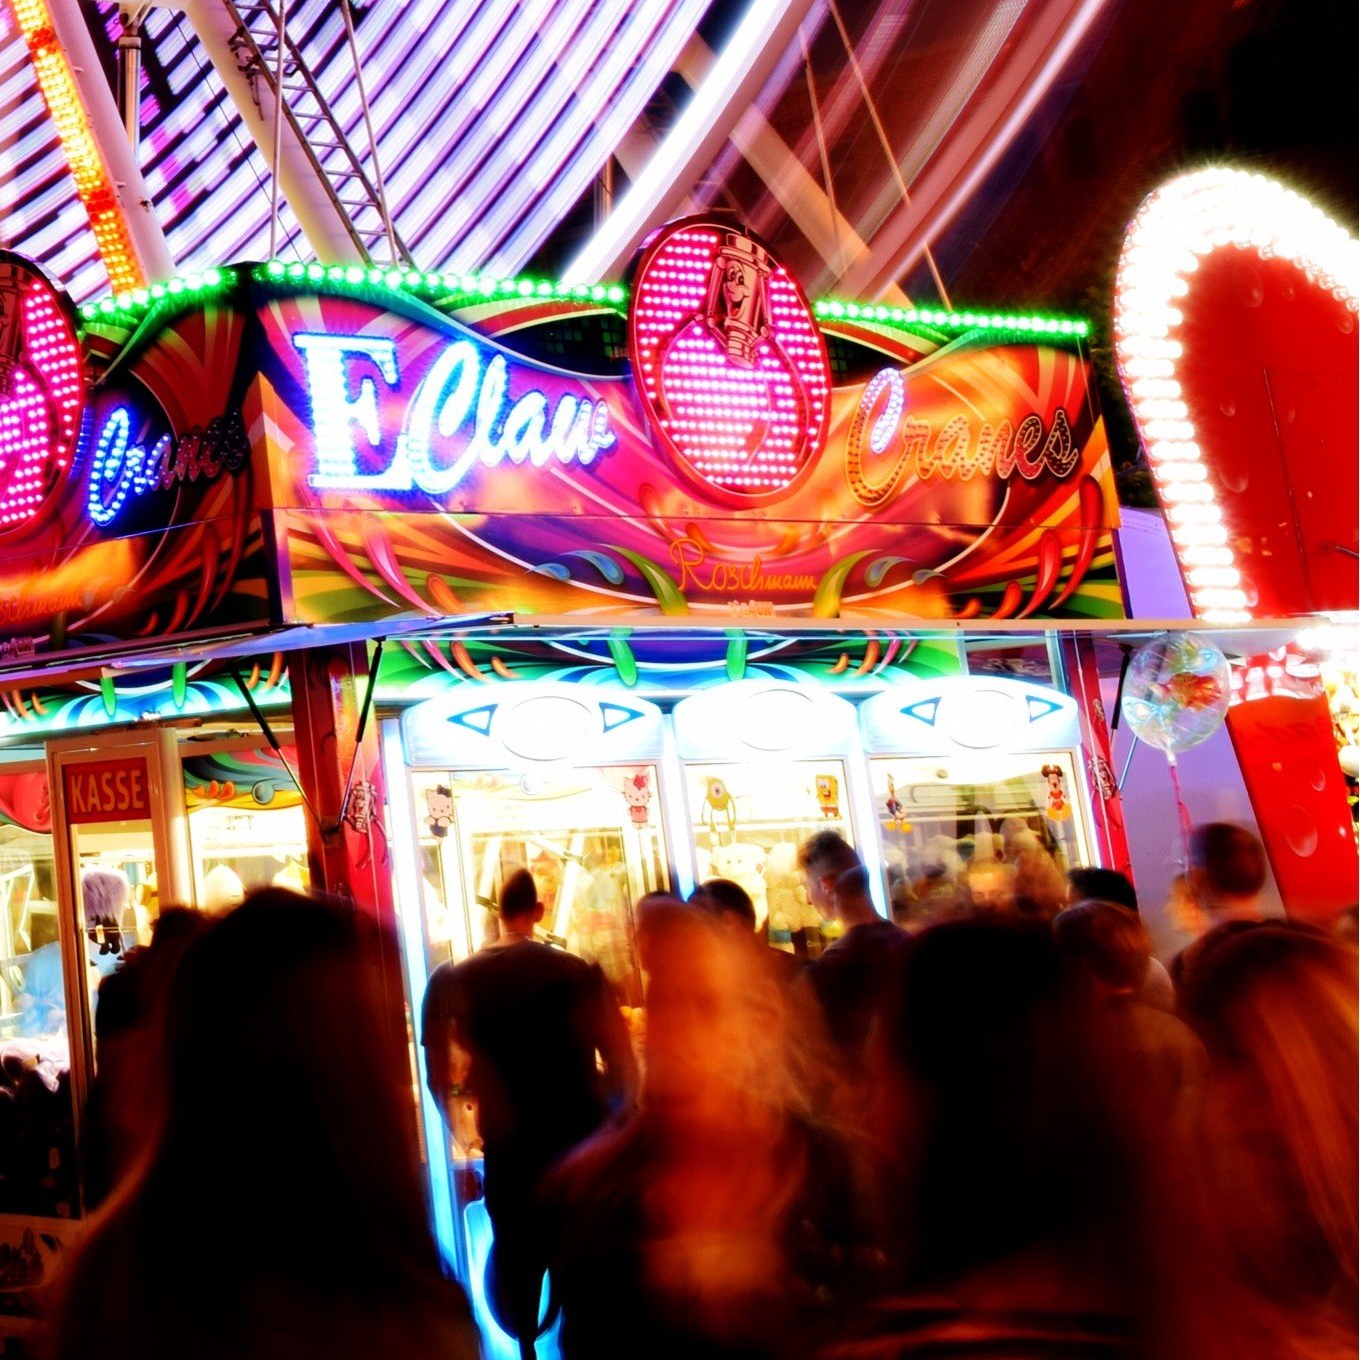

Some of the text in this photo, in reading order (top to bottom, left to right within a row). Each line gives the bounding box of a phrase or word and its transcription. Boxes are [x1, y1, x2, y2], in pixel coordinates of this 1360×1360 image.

[89, 406, 249, 527] Cranes
[845, 366, 1079, 507] Cranes
[70, 768, 145, 814] KASSE
